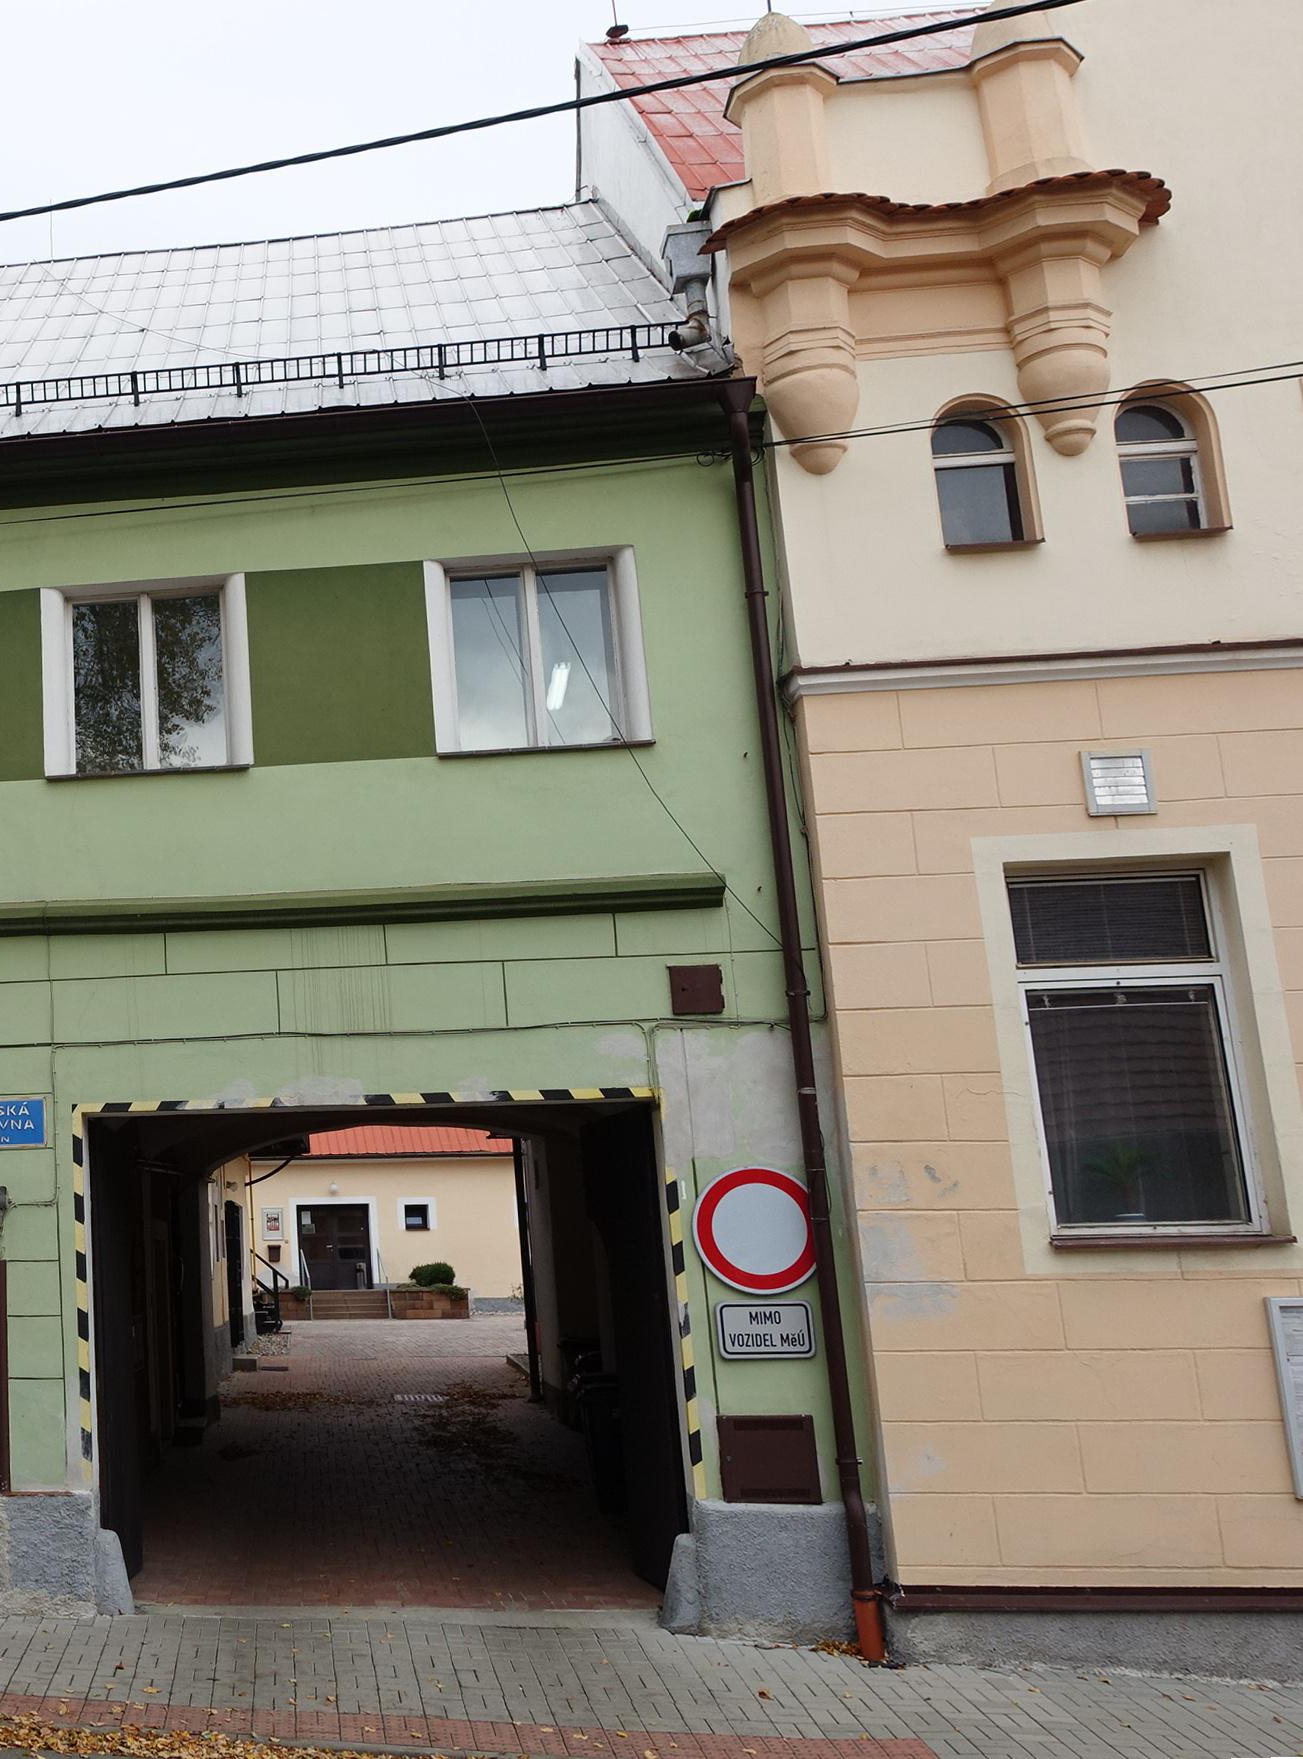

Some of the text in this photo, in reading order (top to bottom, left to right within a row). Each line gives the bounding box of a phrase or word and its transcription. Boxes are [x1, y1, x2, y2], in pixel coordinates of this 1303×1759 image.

[749, 1311, 781, 1325] MIMO
[729, 1330, 805, 1347] VOZIDEL MěÚ
